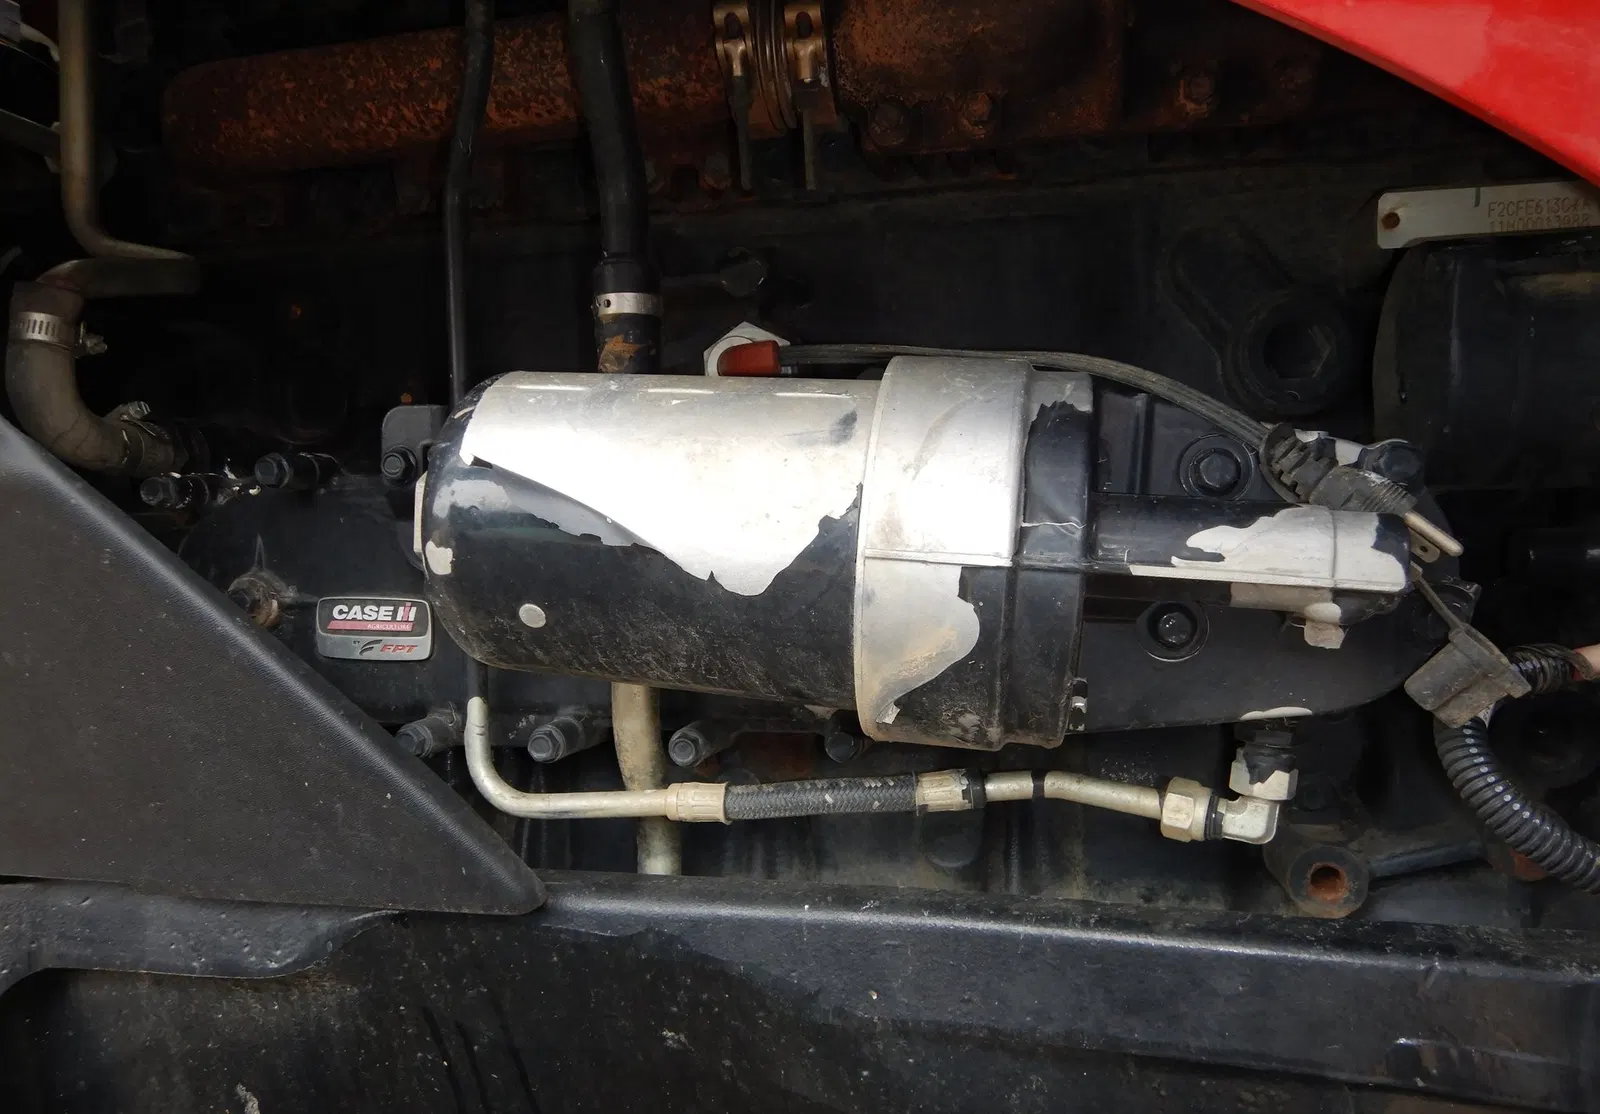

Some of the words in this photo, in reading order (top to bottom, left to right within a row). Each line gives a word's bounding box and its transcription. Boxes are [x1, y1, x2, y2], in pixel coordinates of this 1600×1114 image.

[332, 604, 394, 621] CASE
[367, 623, 413, 631] AGRICULTURE
[380, 644, 418, 654] FPT
